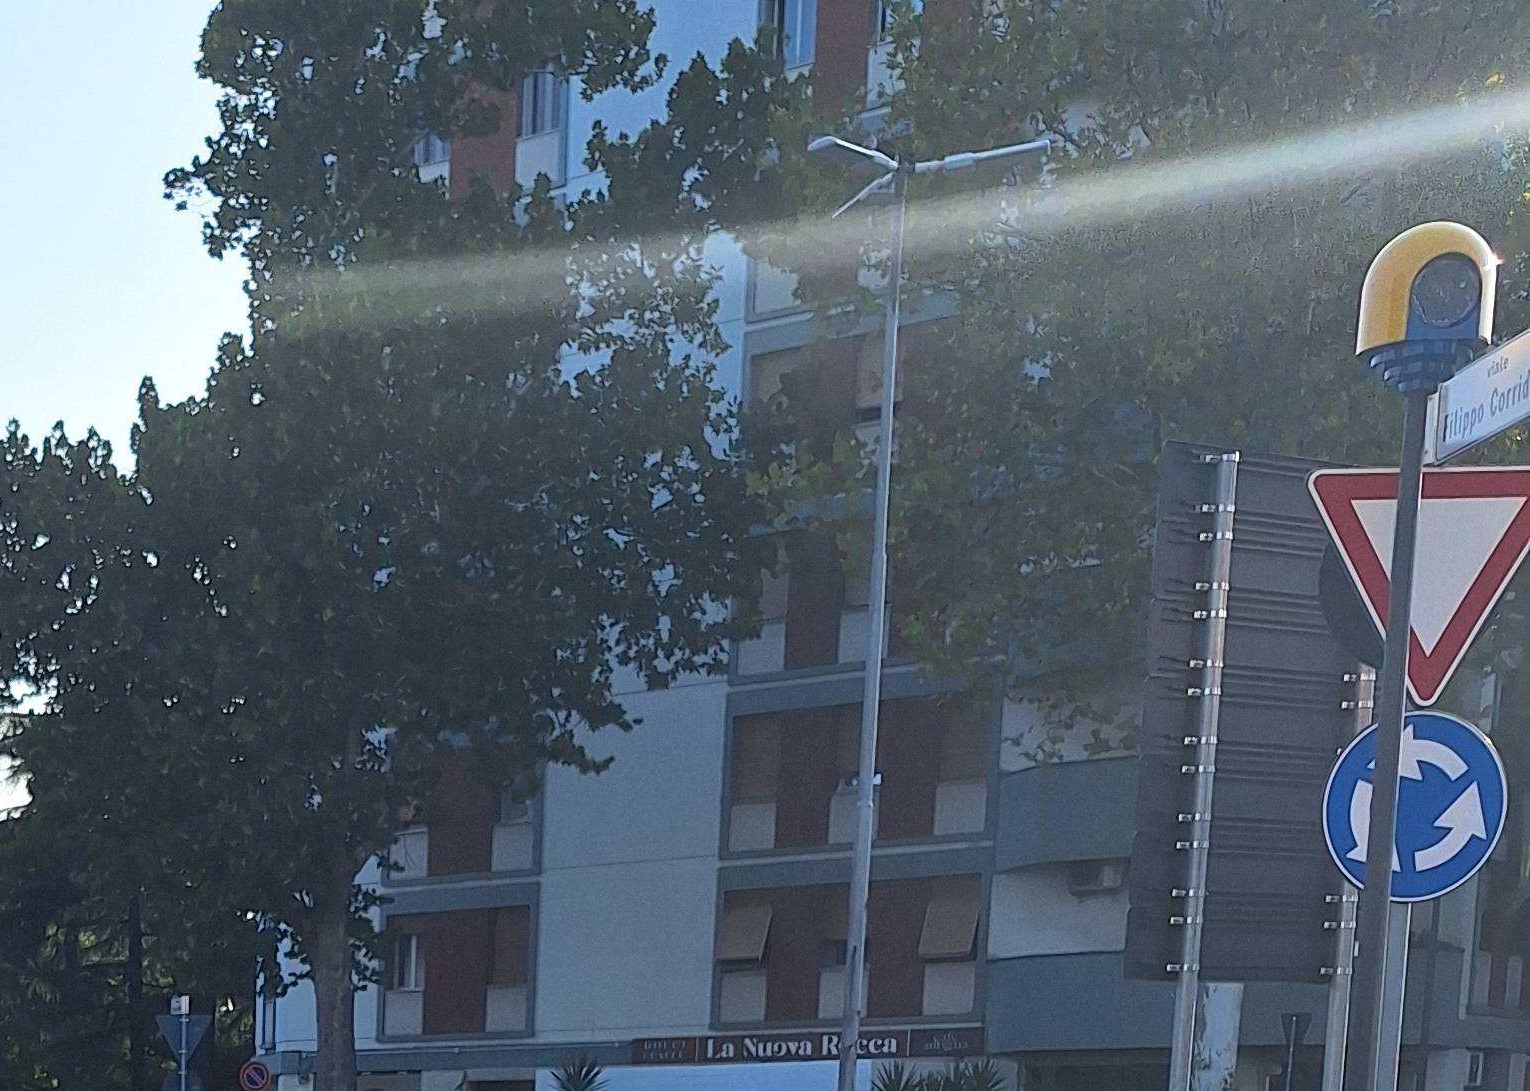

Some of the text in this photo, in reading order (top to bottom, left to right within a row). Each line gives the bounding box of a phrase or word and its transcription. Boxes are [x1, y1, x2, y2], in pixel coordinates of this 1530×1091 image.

[1487, 356, 1509, 378] viale
[1443, 403, 1484, 443] Filippo
[706, 1038, 735, 1059] La
[742, 1037, 812, 1058] Nuova
[822, 1034, 897, 1056] Rcca
